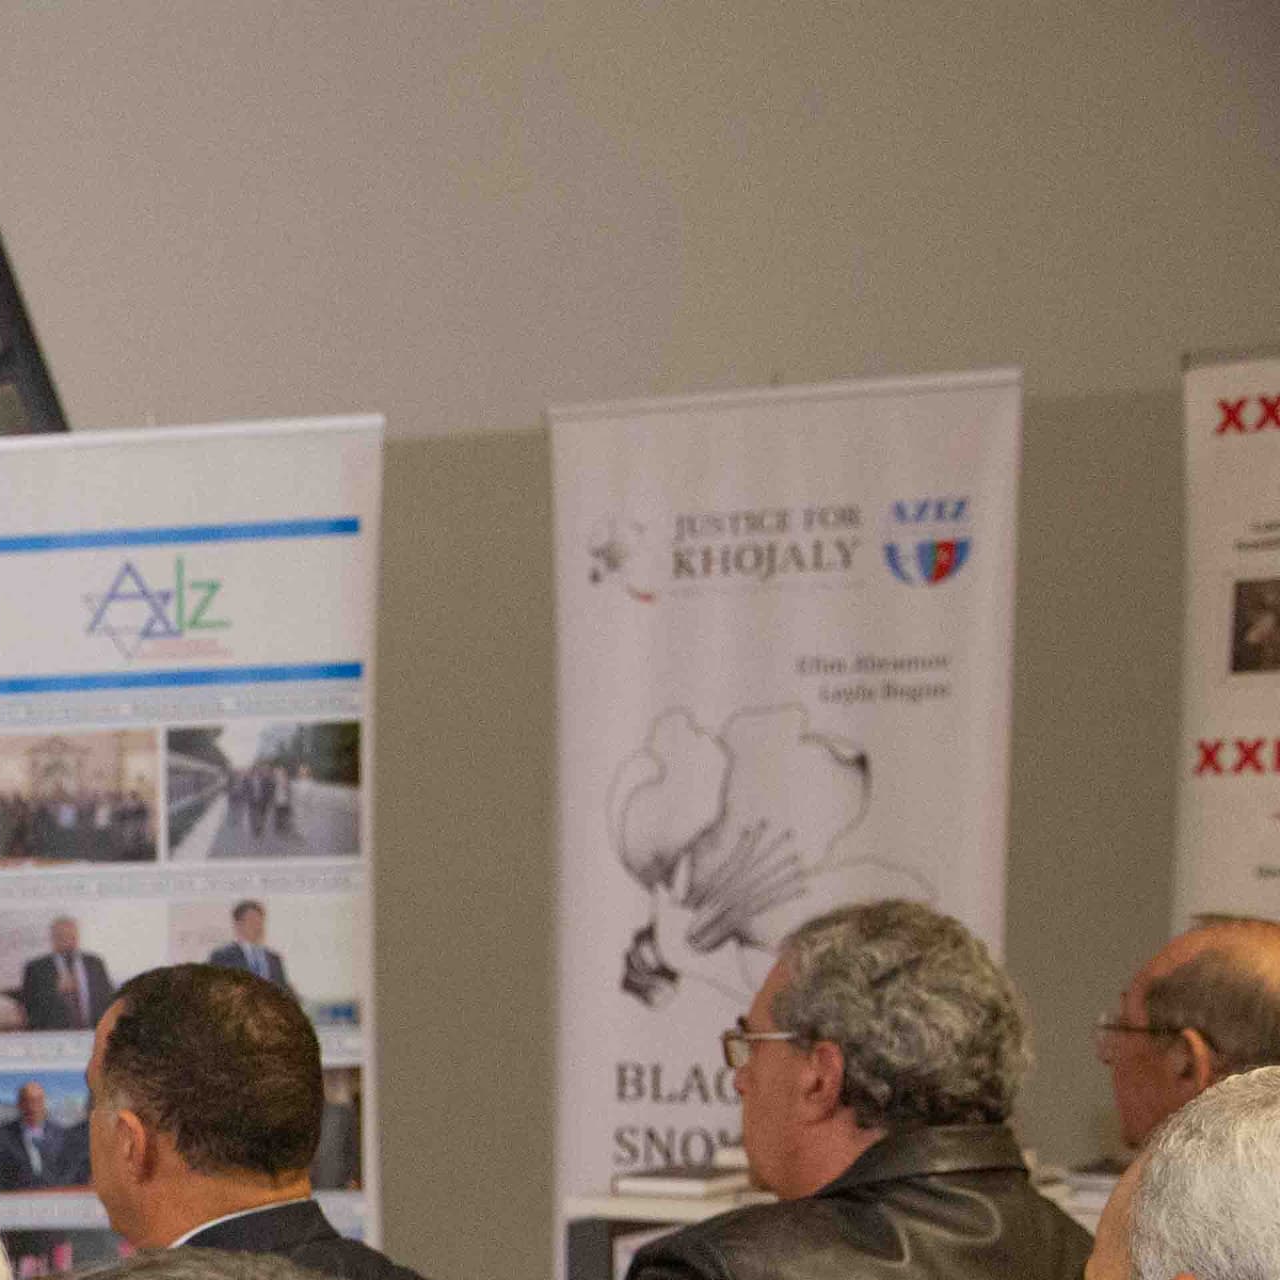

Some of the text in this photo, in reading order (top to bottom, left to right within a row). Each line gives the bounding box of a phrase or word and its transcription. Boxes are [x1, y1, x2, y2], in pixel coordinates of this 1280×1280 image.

[674, 504, 862, 541] JUSTICE FOR
[671, 537, 862, 581] KHOJALY
